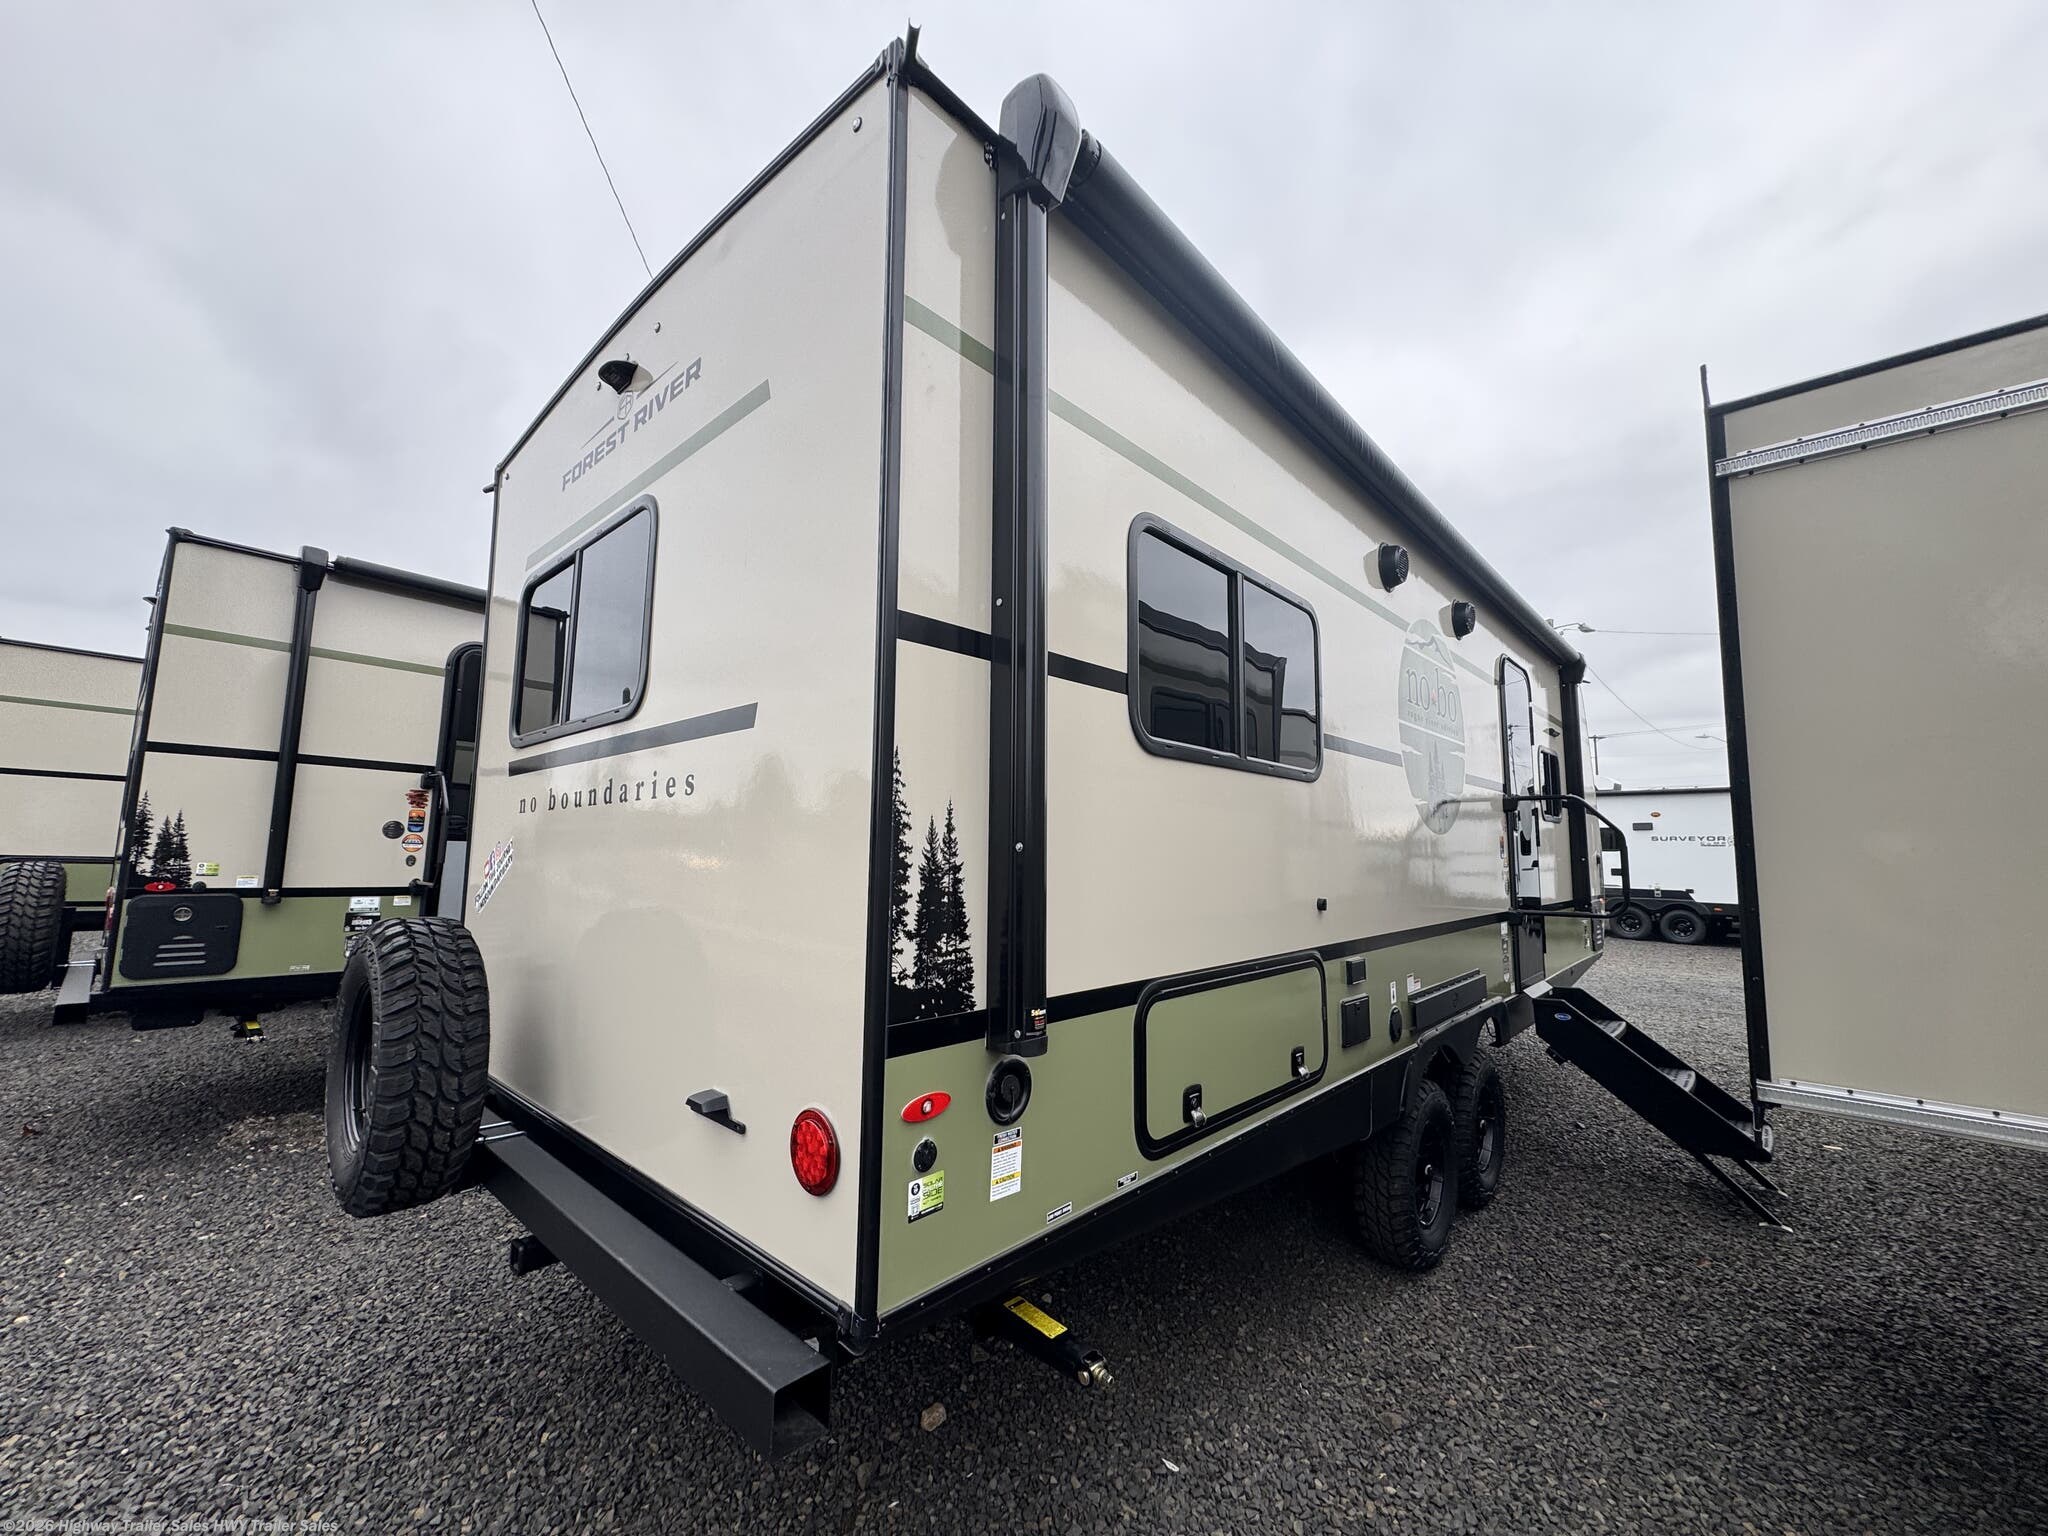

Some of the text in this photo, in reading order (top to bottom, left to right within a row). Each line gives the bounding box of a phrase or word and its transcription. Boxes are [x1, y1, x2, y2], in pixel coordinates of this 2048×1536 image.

[562, 357, 702, 492] FOREST RIVER
[519, 770, 696, 814] no boundaries
[923, 1186, 943, 1200] SIDE
